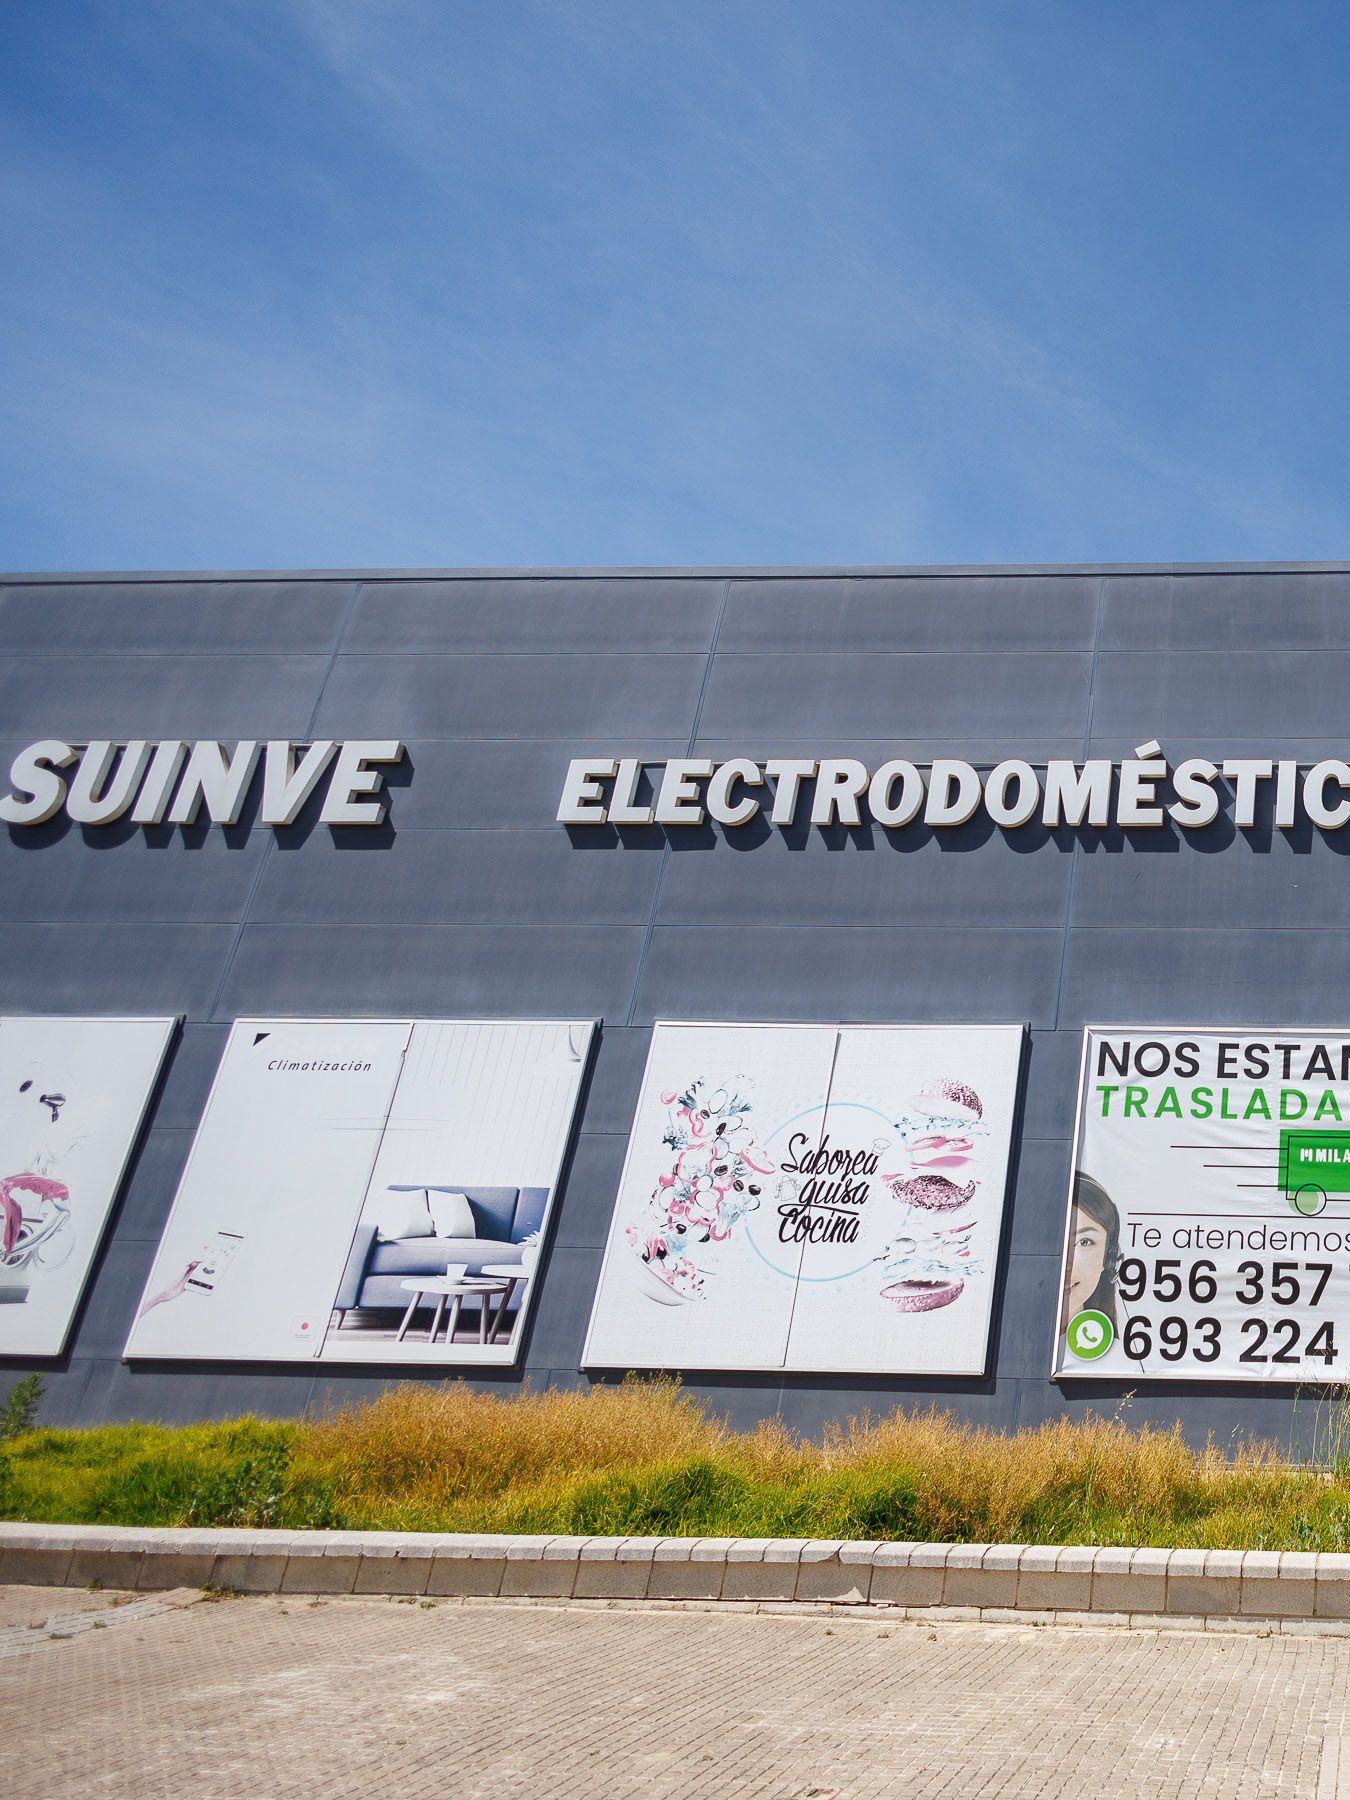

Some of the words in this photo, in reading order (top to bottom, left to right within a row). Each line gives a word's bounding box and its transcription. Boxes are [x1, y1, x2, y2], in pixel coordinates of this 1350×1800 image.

[0, 740, 403, 825] SUINVE
[267, 1059, 372, 1072] Climatización
[1097, 1041, 1200, 1079] NOS
[780, 1132, 879, 1182] Saborea
[778, 1178, 870, 1217] guisa
[778, 1207, 861, 1243] Cocina
[1127, 1223, 1162, 1249] Te
[1118, 1258, 1218, 1304] 956
[1235, 1261, 1333, 1306] 357
[1122, 1316, 1222, 1362] 693
[1239, 1318, 1338, 1365] 224
